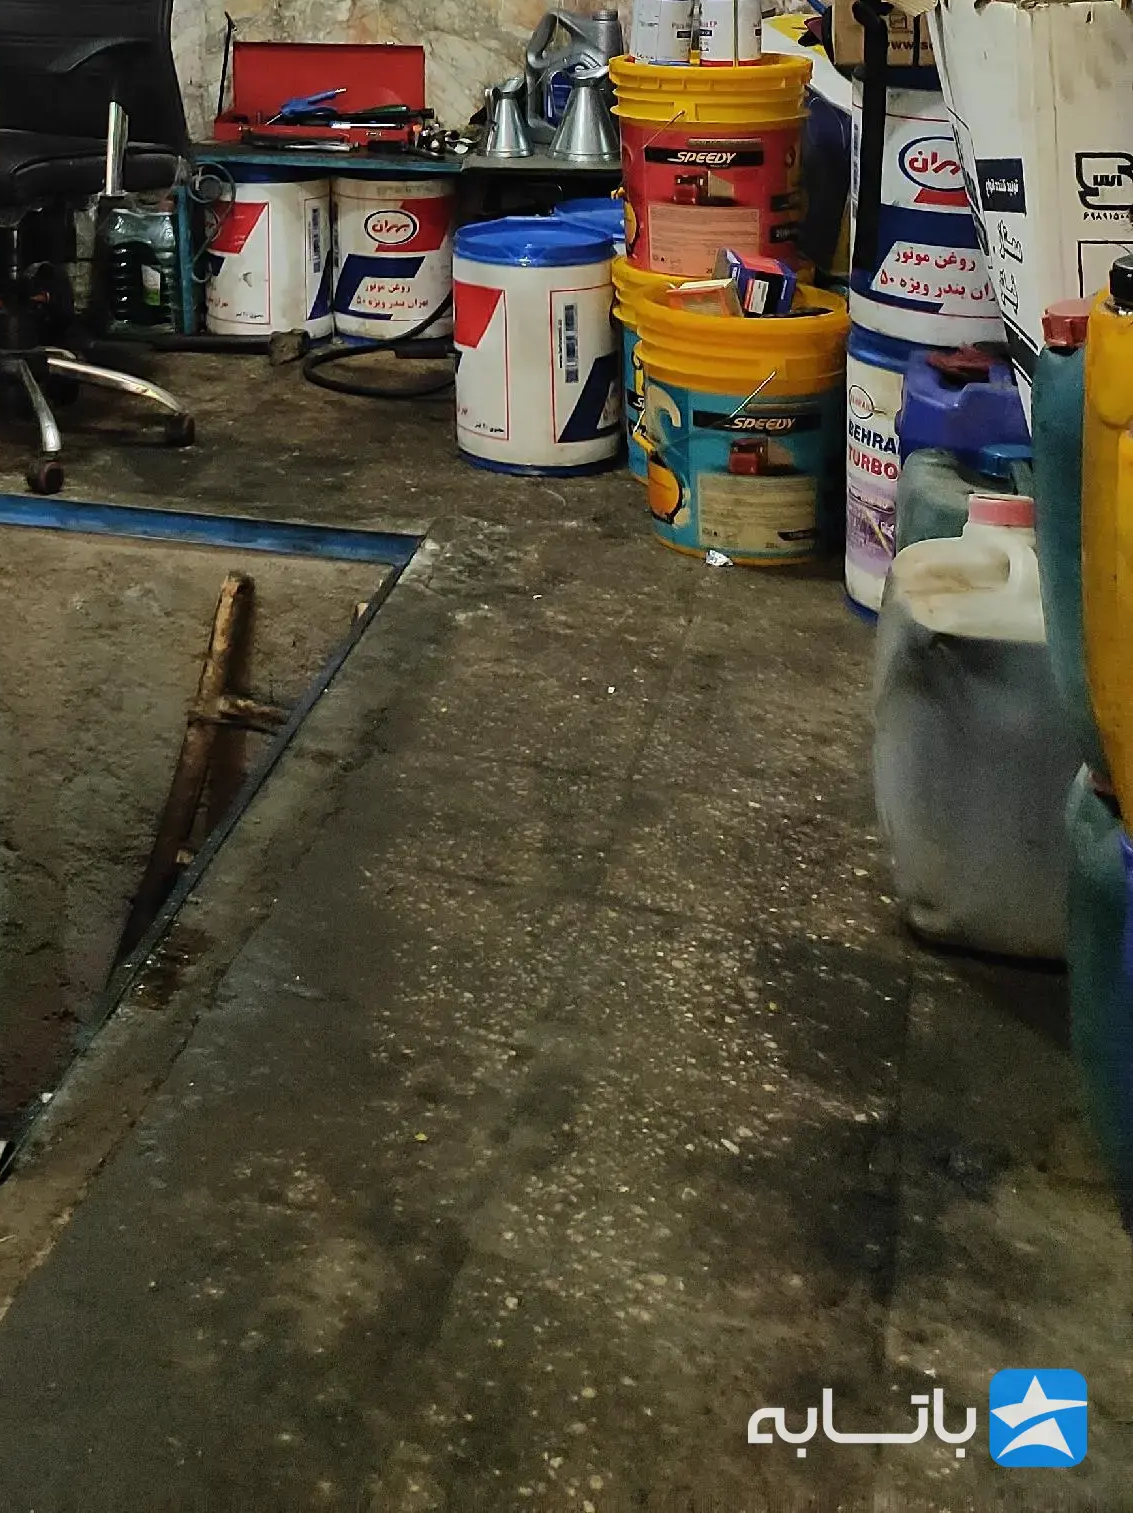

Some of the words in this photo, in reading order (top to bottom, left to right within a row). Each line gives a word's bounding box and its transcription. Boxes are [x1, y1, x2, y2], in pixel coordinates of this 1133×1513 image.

[676, 151, 737, 164] SPEEDY
[371, 218, 412, 234] بهران
[894, 246, 931, 267] موتور
[935, 251, 977, 272] روغن
[364, 282, 387, 293] موتور
[387, 283, 412, 294] روغن
[899, 276, 930, 297] ویژه
[934, 283, 967, 298] بندر
[732, 417, 796, 431] SPEEDY
[848, 443, 899, 481] TURBO
